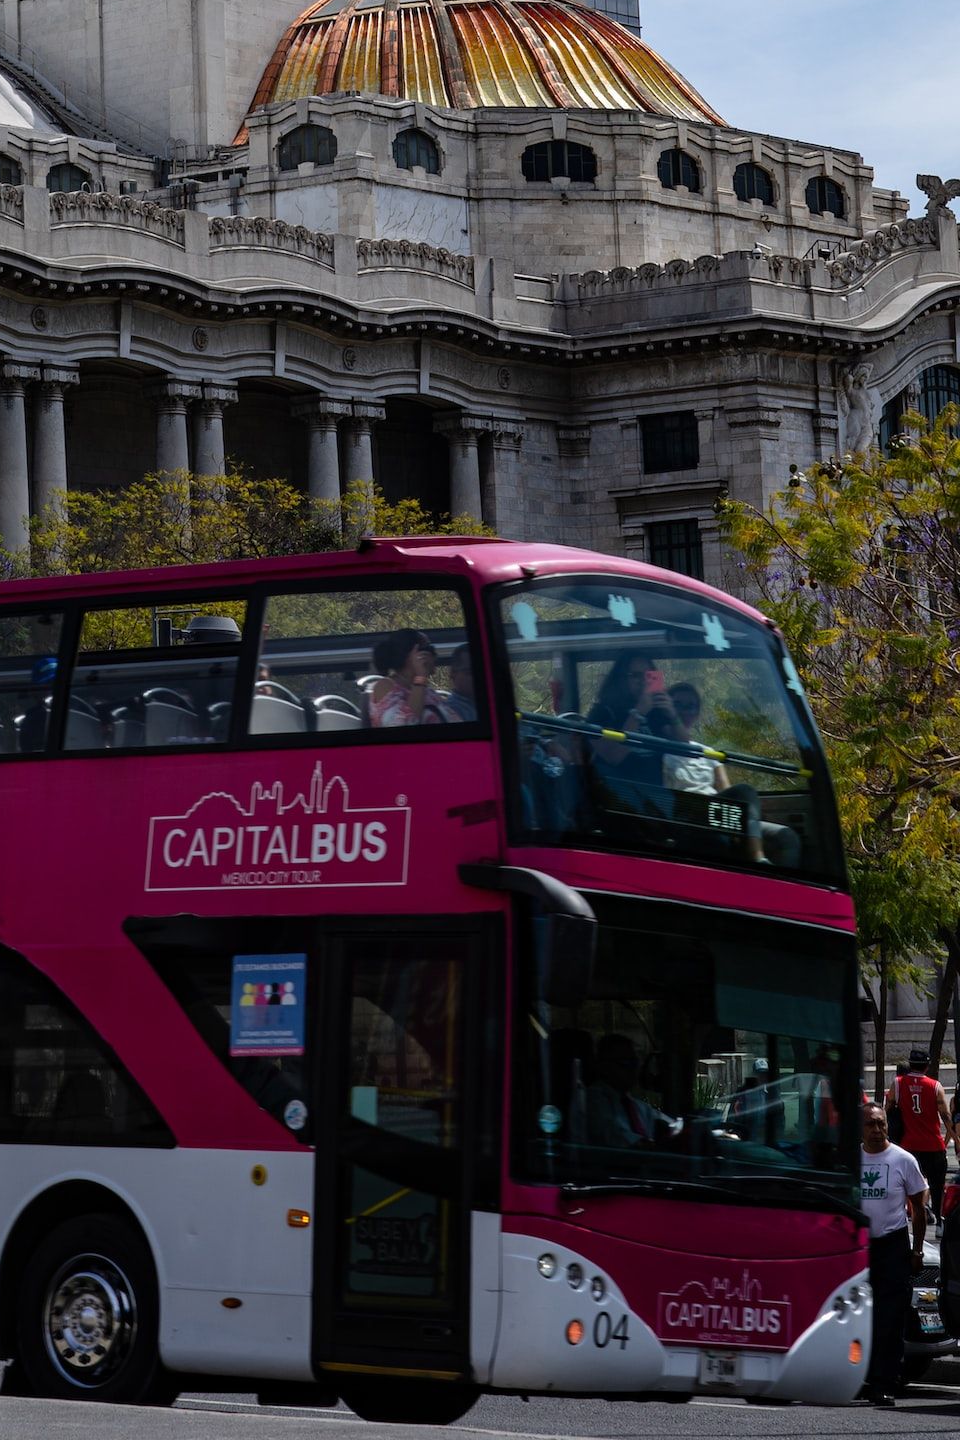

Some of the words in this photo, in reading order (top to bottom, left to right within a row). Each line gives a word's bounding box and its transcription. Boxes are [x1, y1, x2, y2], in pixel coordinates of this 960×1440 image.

[162, 821, 388, 868] CAPITALBUS
[911, 1093, 922, 1114] 1
[592, 1310, 630, 1350] 04
[665, 1301, 781, 1334] CAPITALBUS
